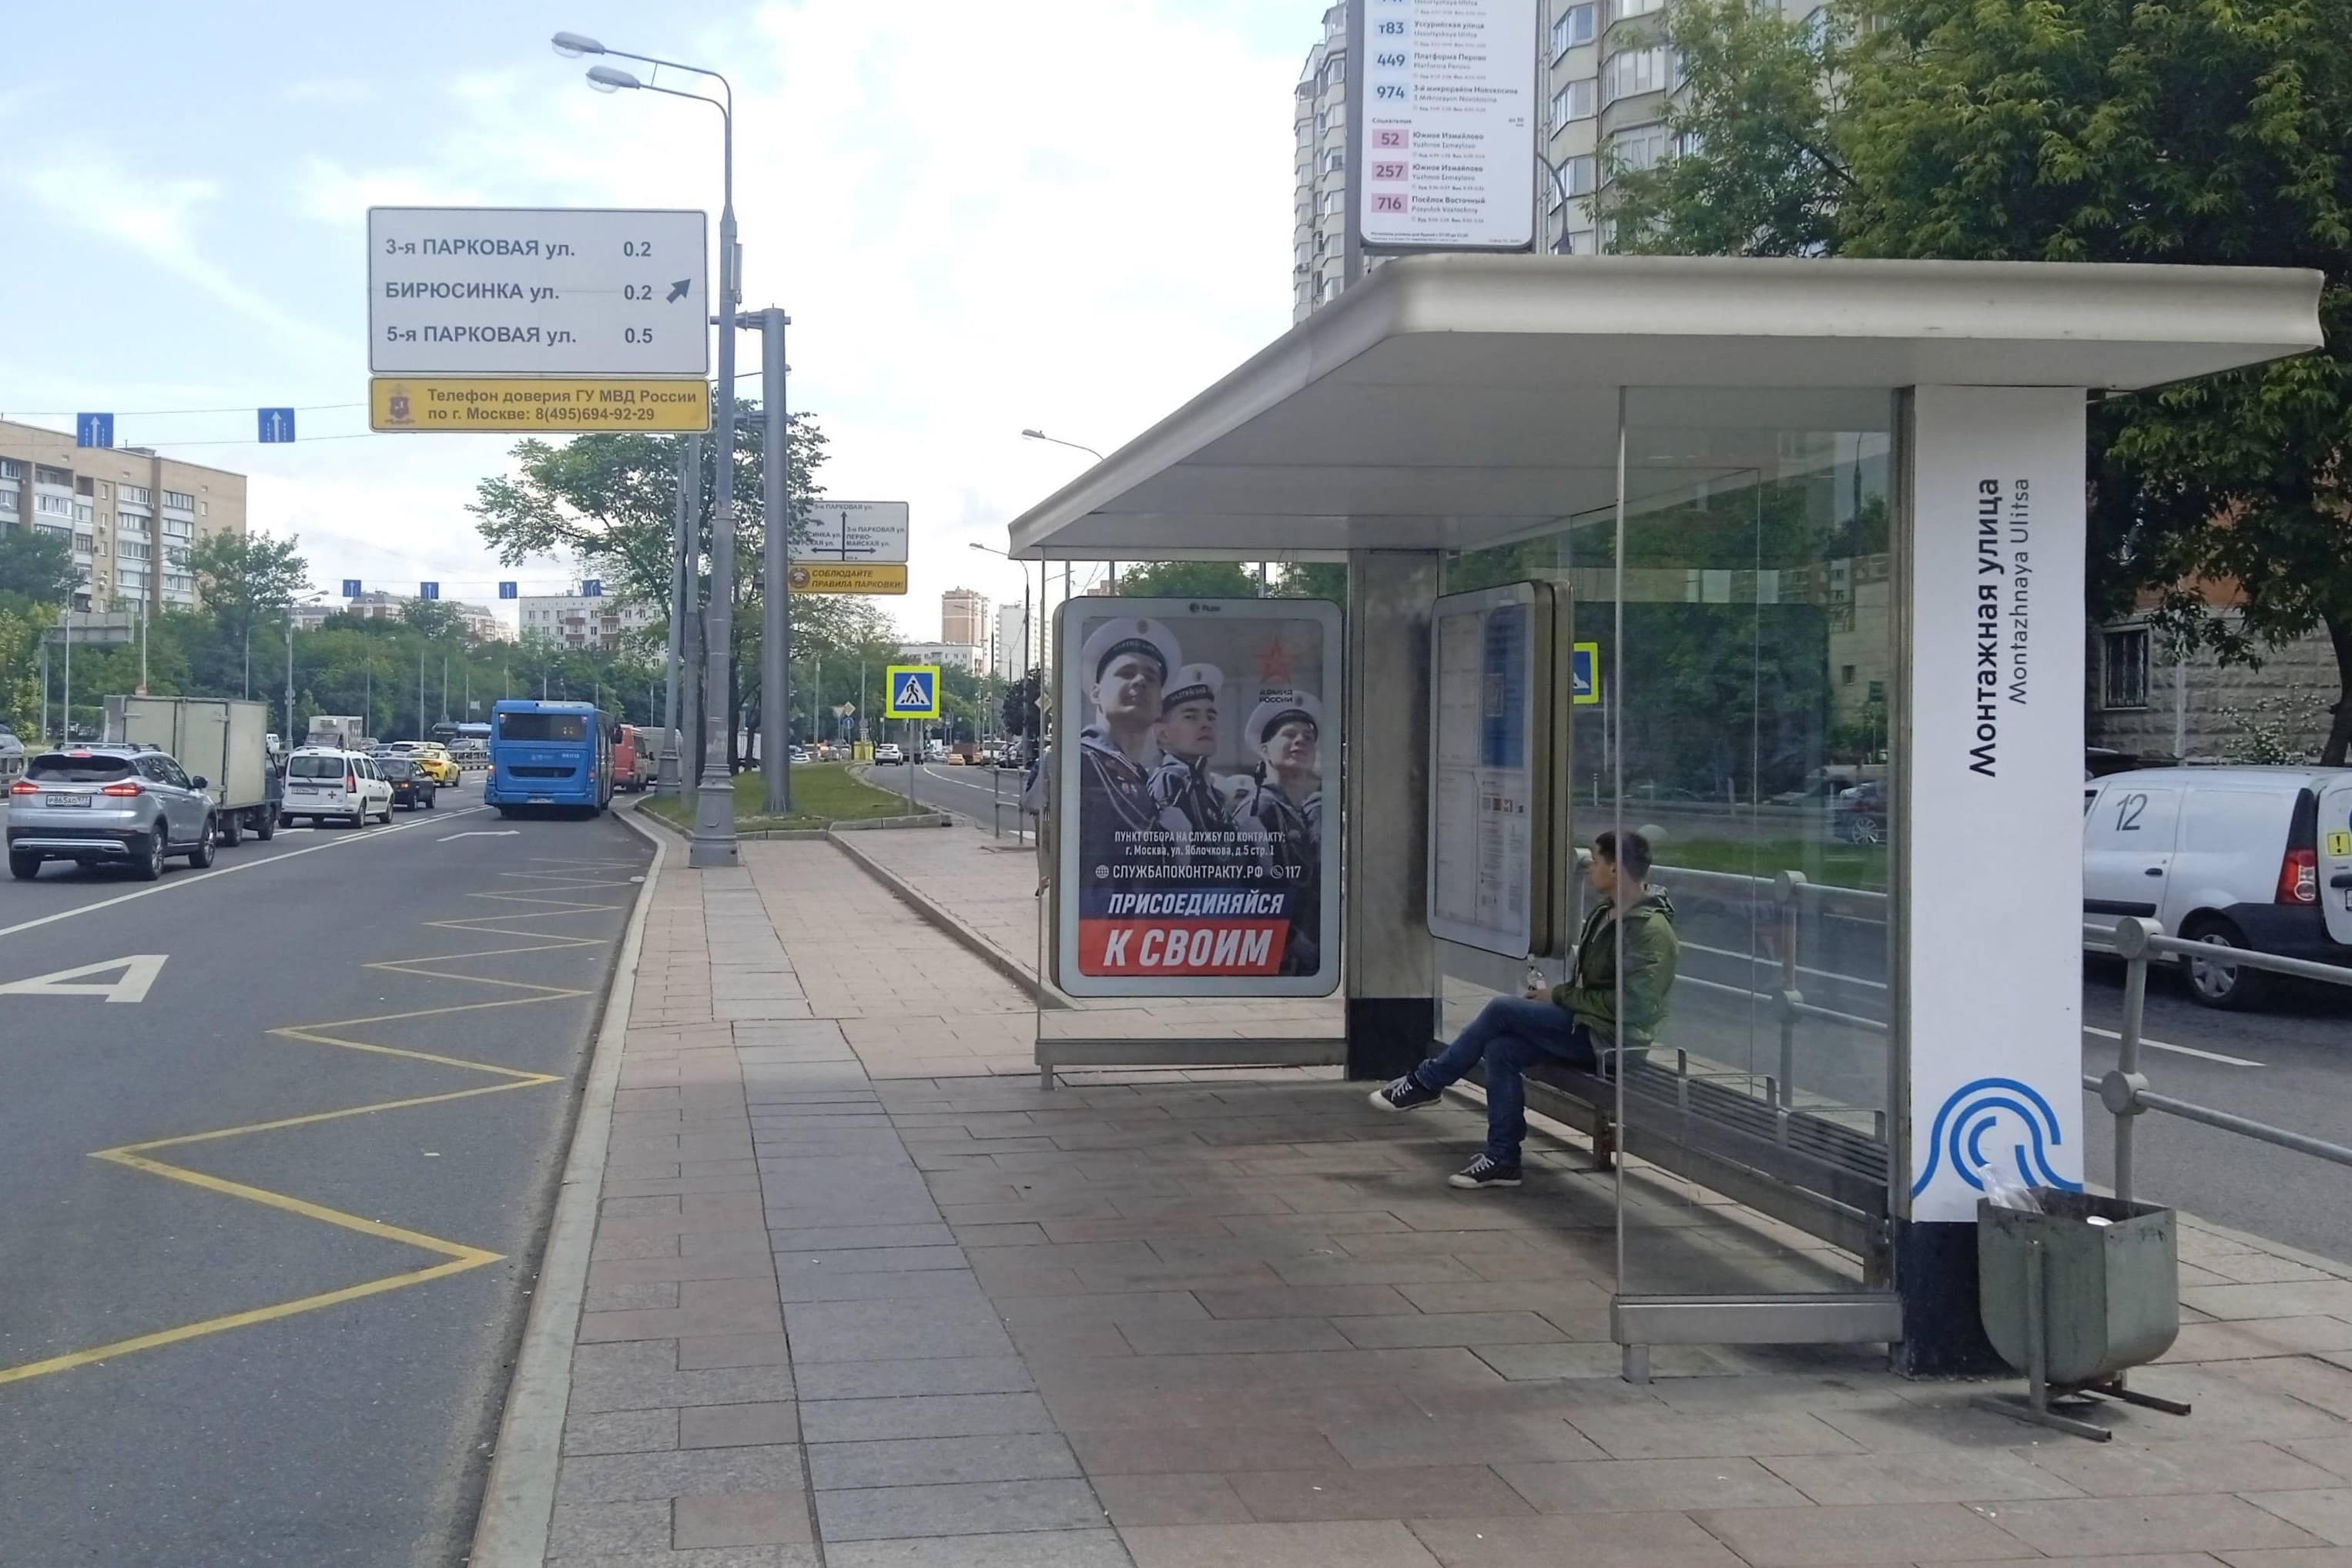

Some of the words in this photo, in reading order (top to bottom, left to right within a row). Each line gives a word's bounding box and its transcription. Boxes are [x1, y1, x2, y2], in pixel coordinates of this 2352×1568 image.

[1379, 22, 1404, 35] т83
[1377, 54, 1406, 67] 449
[1414, 52, 1457, 62] Платформа
[1459, 53, 1486, 62] Перово
[1377, 85, 1405, 99] 974
[1427, 85, 1473, 94] микрорайон
[1382, 133, 1399, 146] 52
[1376, 165, 1403, 178] 257
[1378, 196, 1402, 210] 716
[386, 239, 416, 256] 3-я
[423, 239, 539, 256] ПАРКОВАЯ
[546, 243, 575, 260] ул.
[623, 241, 652, 257] 0.2
[386, 282, 523, 300] БИРЮСИНКА
[530, 286, 559, 303] ул.
[624, 284, 652, 300] 0.2
[387, 326, 417, 343] 5-я
[424, 326, 540, 343] ПАРКОВАЯ
[547, 329, 576, 346] ул.
[625, 327, 653, 343] 0.5
[427, 388, 499, 406] Телефон
[503, 390, 571, 405] доверия
[576, 390, 596, 404] ГУ
[599, 390, 635, 406] МВД
[640, 390, 697, 404] России
[428, 409, 447, 421] по
[452, 410, 461, 420] г.
[467, 407, 531, 421] Москве:
[535, 407, 655, 424] 8(495)694-92-29
[2010, 479, 2029, 543] Ulitsa
[1978, 479, 2004, 575] улица
[812, 569, 873, 578] СОБЛЮДАЙТЕ
[2009, 551, 2032, 705] Montazhnaya
[1969, 585, 1999, 777] Монтажная
[2116, 793, 2148, 831] 12
[1115, 832, 1141, 843] ПУНКТ
[1143, 832, 1174, 842] ОТБОРА
[1176, 832, 1188, 842] НА
[1188, 832, 1222, 842] СЛУЖБУ
[1224, 832, 1235, 842] ПО
[1237, 832, 1285, 843] КОНТРАКТУ:
[1134, 846, 1170, 857] Москва,
[1171, 848, 1183, 857] ул.
[1185, 846, 1234, 857] Яблочкова,
[1251, 848, 1268, 857] стр.
[1113, 866, 1263, 879] СЛУЖБАПОКОНТРАКТУ.РФ
[1285, 866, 1302, 878] 117
[1107, 890, 1285, 916] ПРИСОЕДИНЯЙСЯ
[1103, 930, 1132, 967] К
[1139, 929, 1273, 967] СВОИМ
